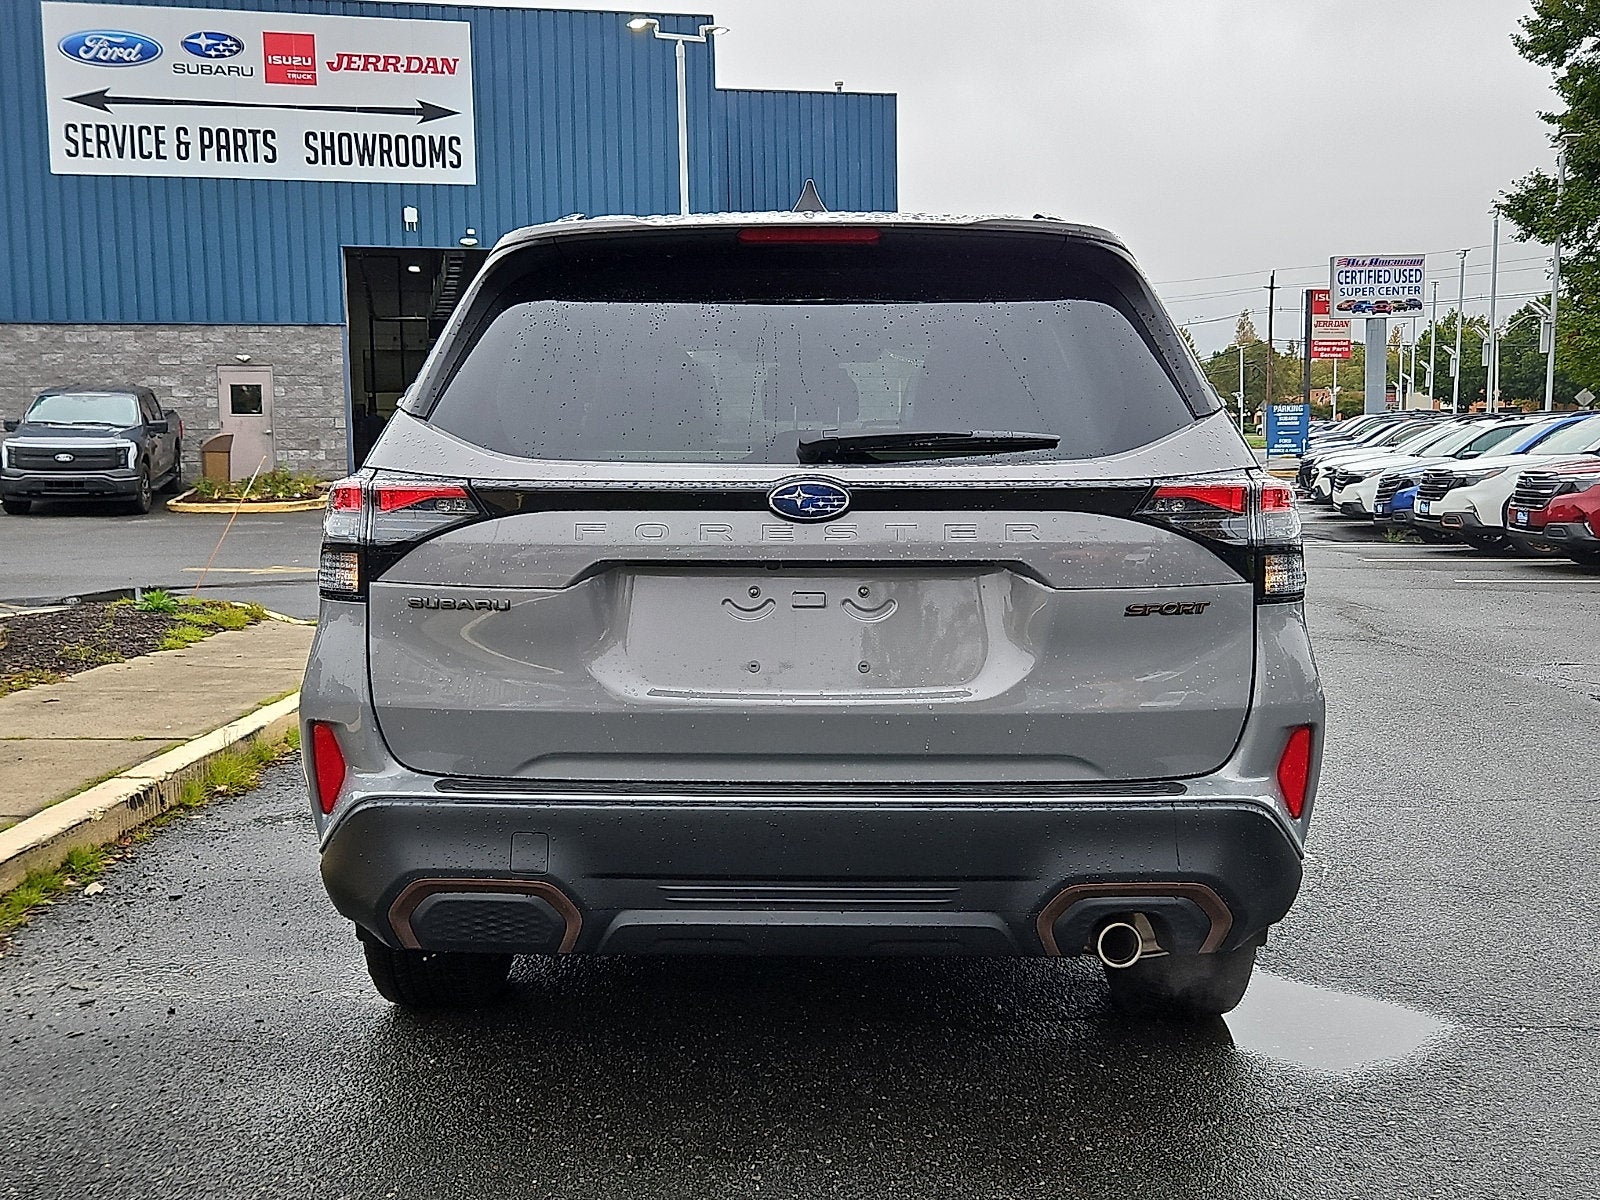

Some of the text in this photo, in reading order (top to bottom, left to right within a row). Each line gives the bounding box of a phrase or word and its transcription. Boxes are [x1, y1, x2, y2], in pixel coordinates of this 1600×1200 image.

[79, 34, 144, 62] Ford
[268, 55, 312, 66] ISUZU
[172, 63, 254, 77] SUBARU
[64, 123, 278, 164] SERVICE & PARTS
[304, 131, 462, 169] SHOWROOMS
[1337, 268, 1423, 285] CERTIFIED USED
[1340, 286, 1421, 296] SUPER CENTER
[575, 522, 1039, 542] FORESTER
[408, 596, 511, 611] SUBARU
[1123, 601, 1211, 617] SPORT
